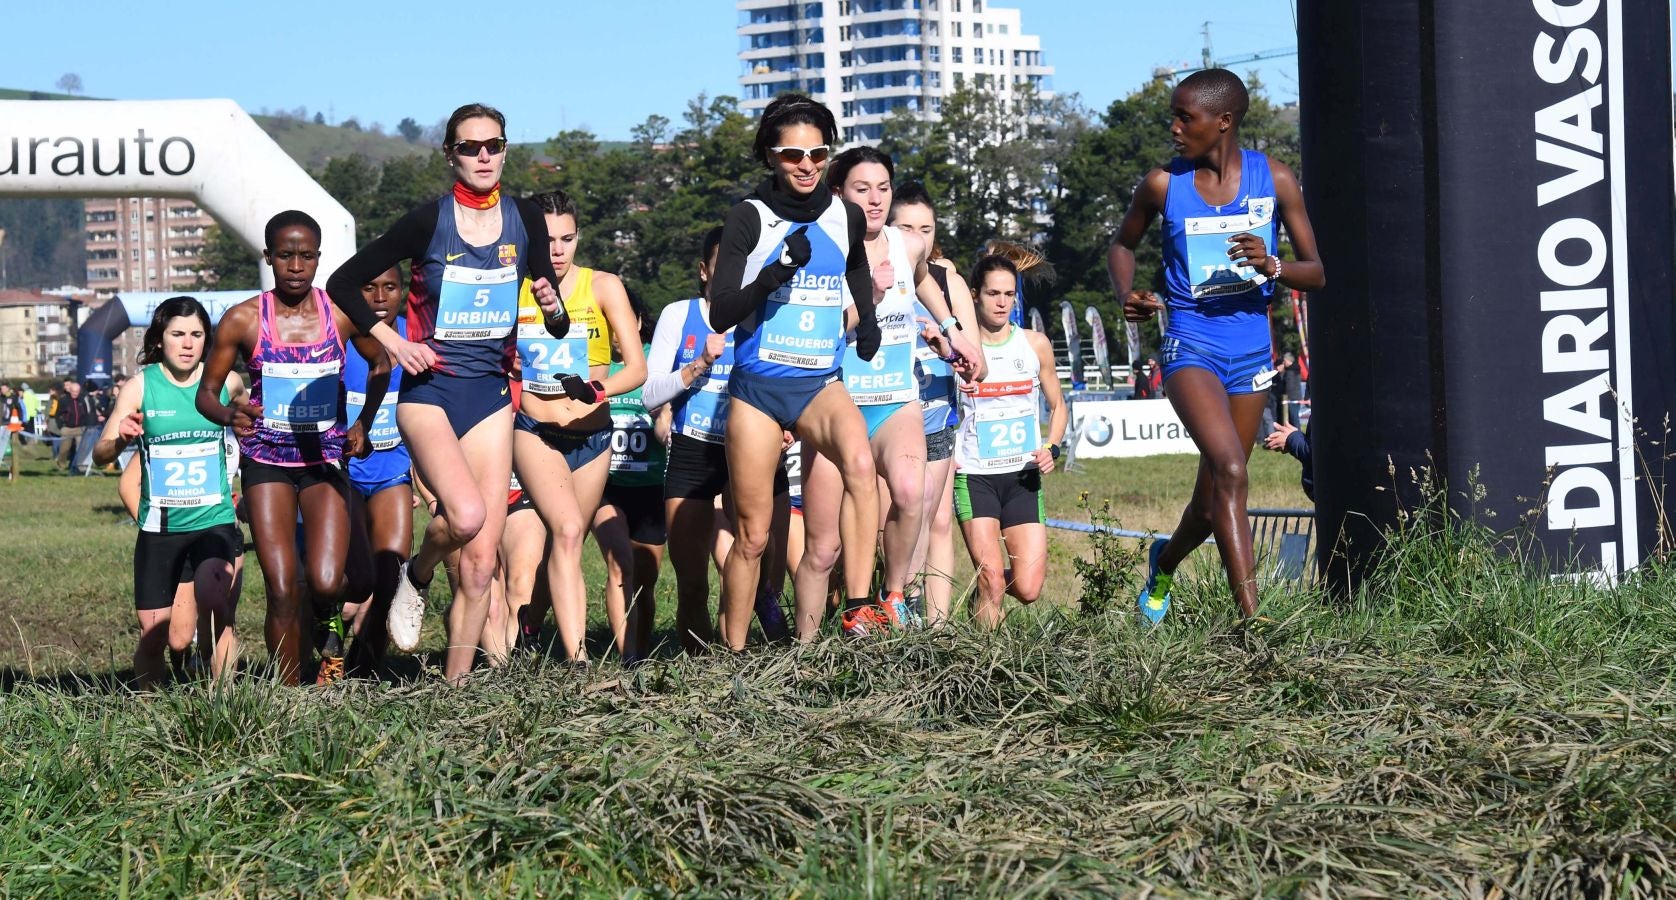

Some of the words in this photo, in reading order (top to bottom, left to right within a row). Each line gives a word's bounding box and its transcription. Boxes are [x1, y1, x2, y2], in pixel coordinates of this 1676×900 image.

[473, 288, 491, 308] 5
[443, 310, 511, 325] URBINA
[798, 310, 816, 332] 8
[587, 327, 601, 340] 71
[766, 332, 835, 350] LUGUEROS
[528, 342, 574, 371] 24
[871, 350, 886, 371] 6
[537, 373, 554, 381] ERI
[847, 371, 905, 389] PEREZ
[1538, 217, 1616, 531] DIARIO
[295, 382, 307, 401] 1
[272, 403, 331, 419] JEBET
[374, 408, 390, 424] 2
[148, 430, 191, 444] GOIERRI
[990, 420, 1027, 448] 26
[164, 460, 208, 487] 25
[167, 487, 206, 497] AINHOA
